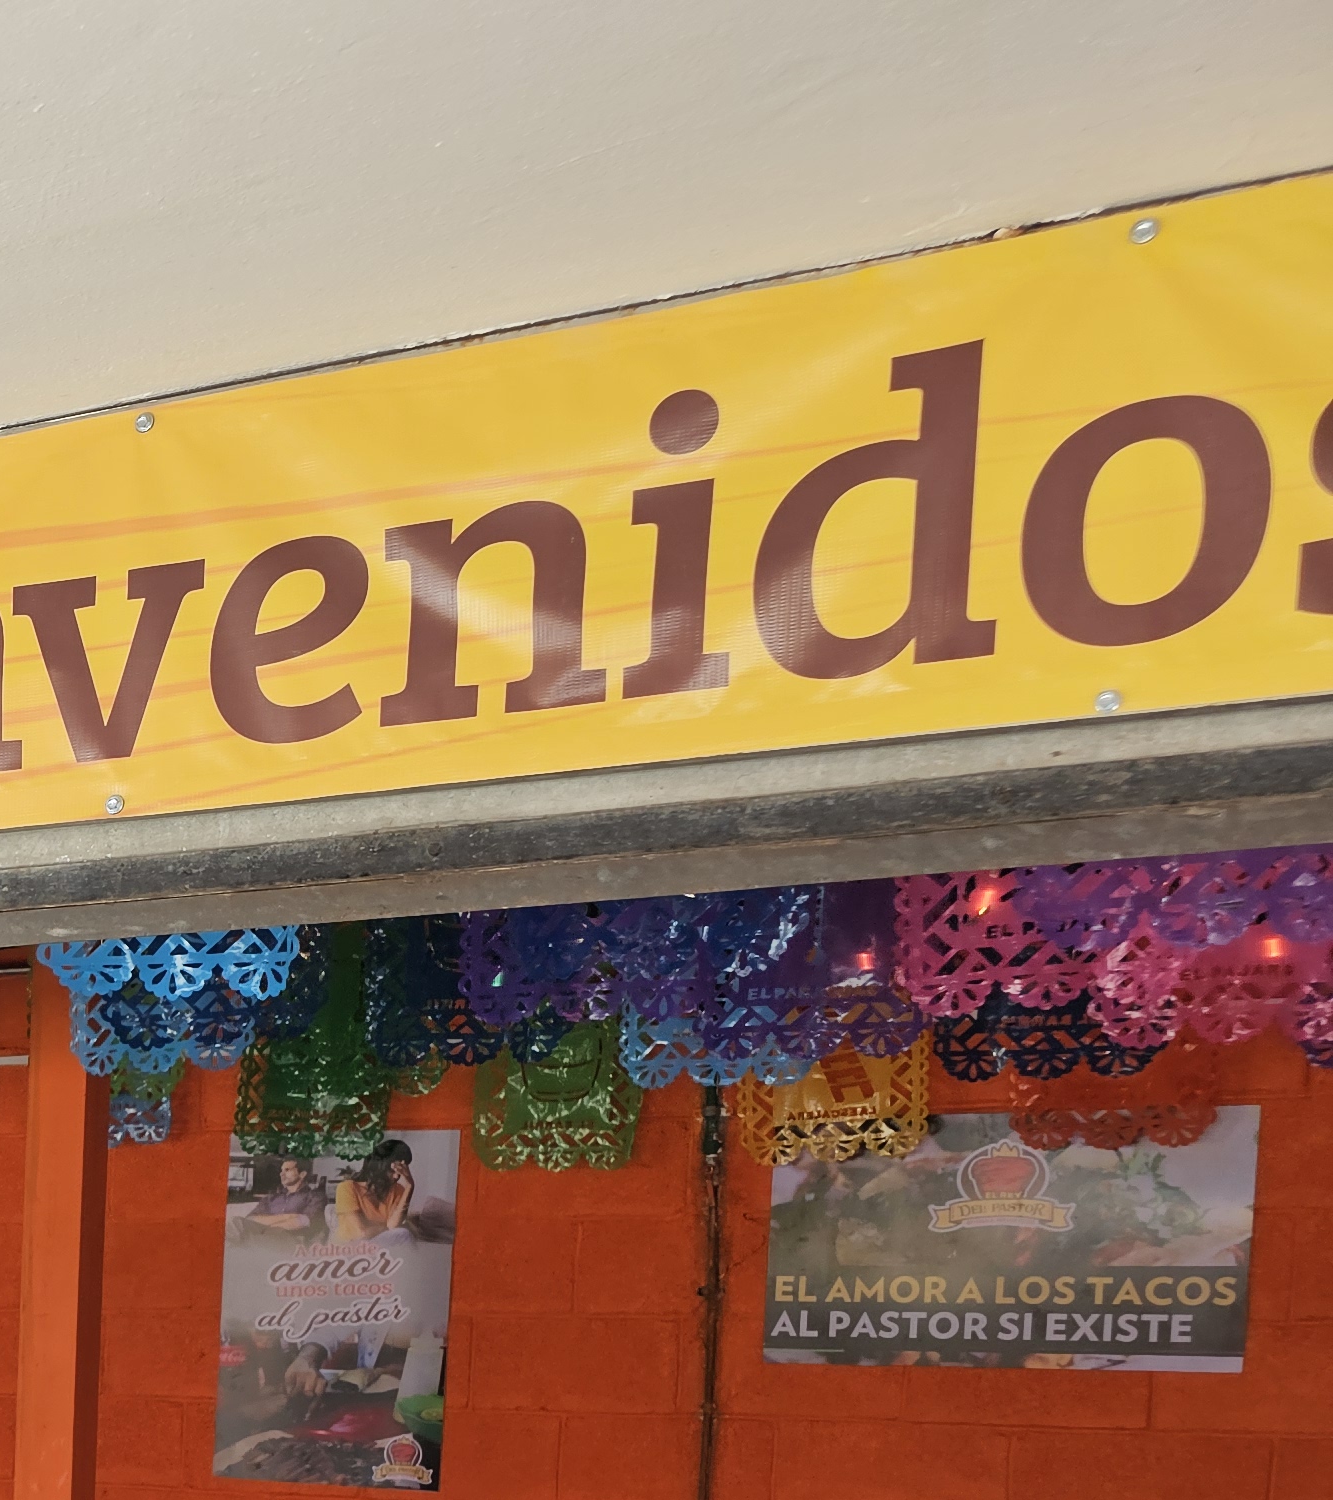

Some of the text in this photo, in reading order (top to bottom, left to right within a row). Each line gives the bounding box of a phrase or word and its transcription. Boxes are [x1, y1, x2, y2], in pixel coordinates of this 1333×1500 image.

[269, 1250, 401, 1283] amor
[276, 1282, 393, 1298] unos tacos
[775, 1275, 1238, 1307] EL AMOR A LOS TACOS
[257, 1297, 408, 1341] al pastor
[770, 1310, 1194, 1344] AL PASTOR SI EXISTE
